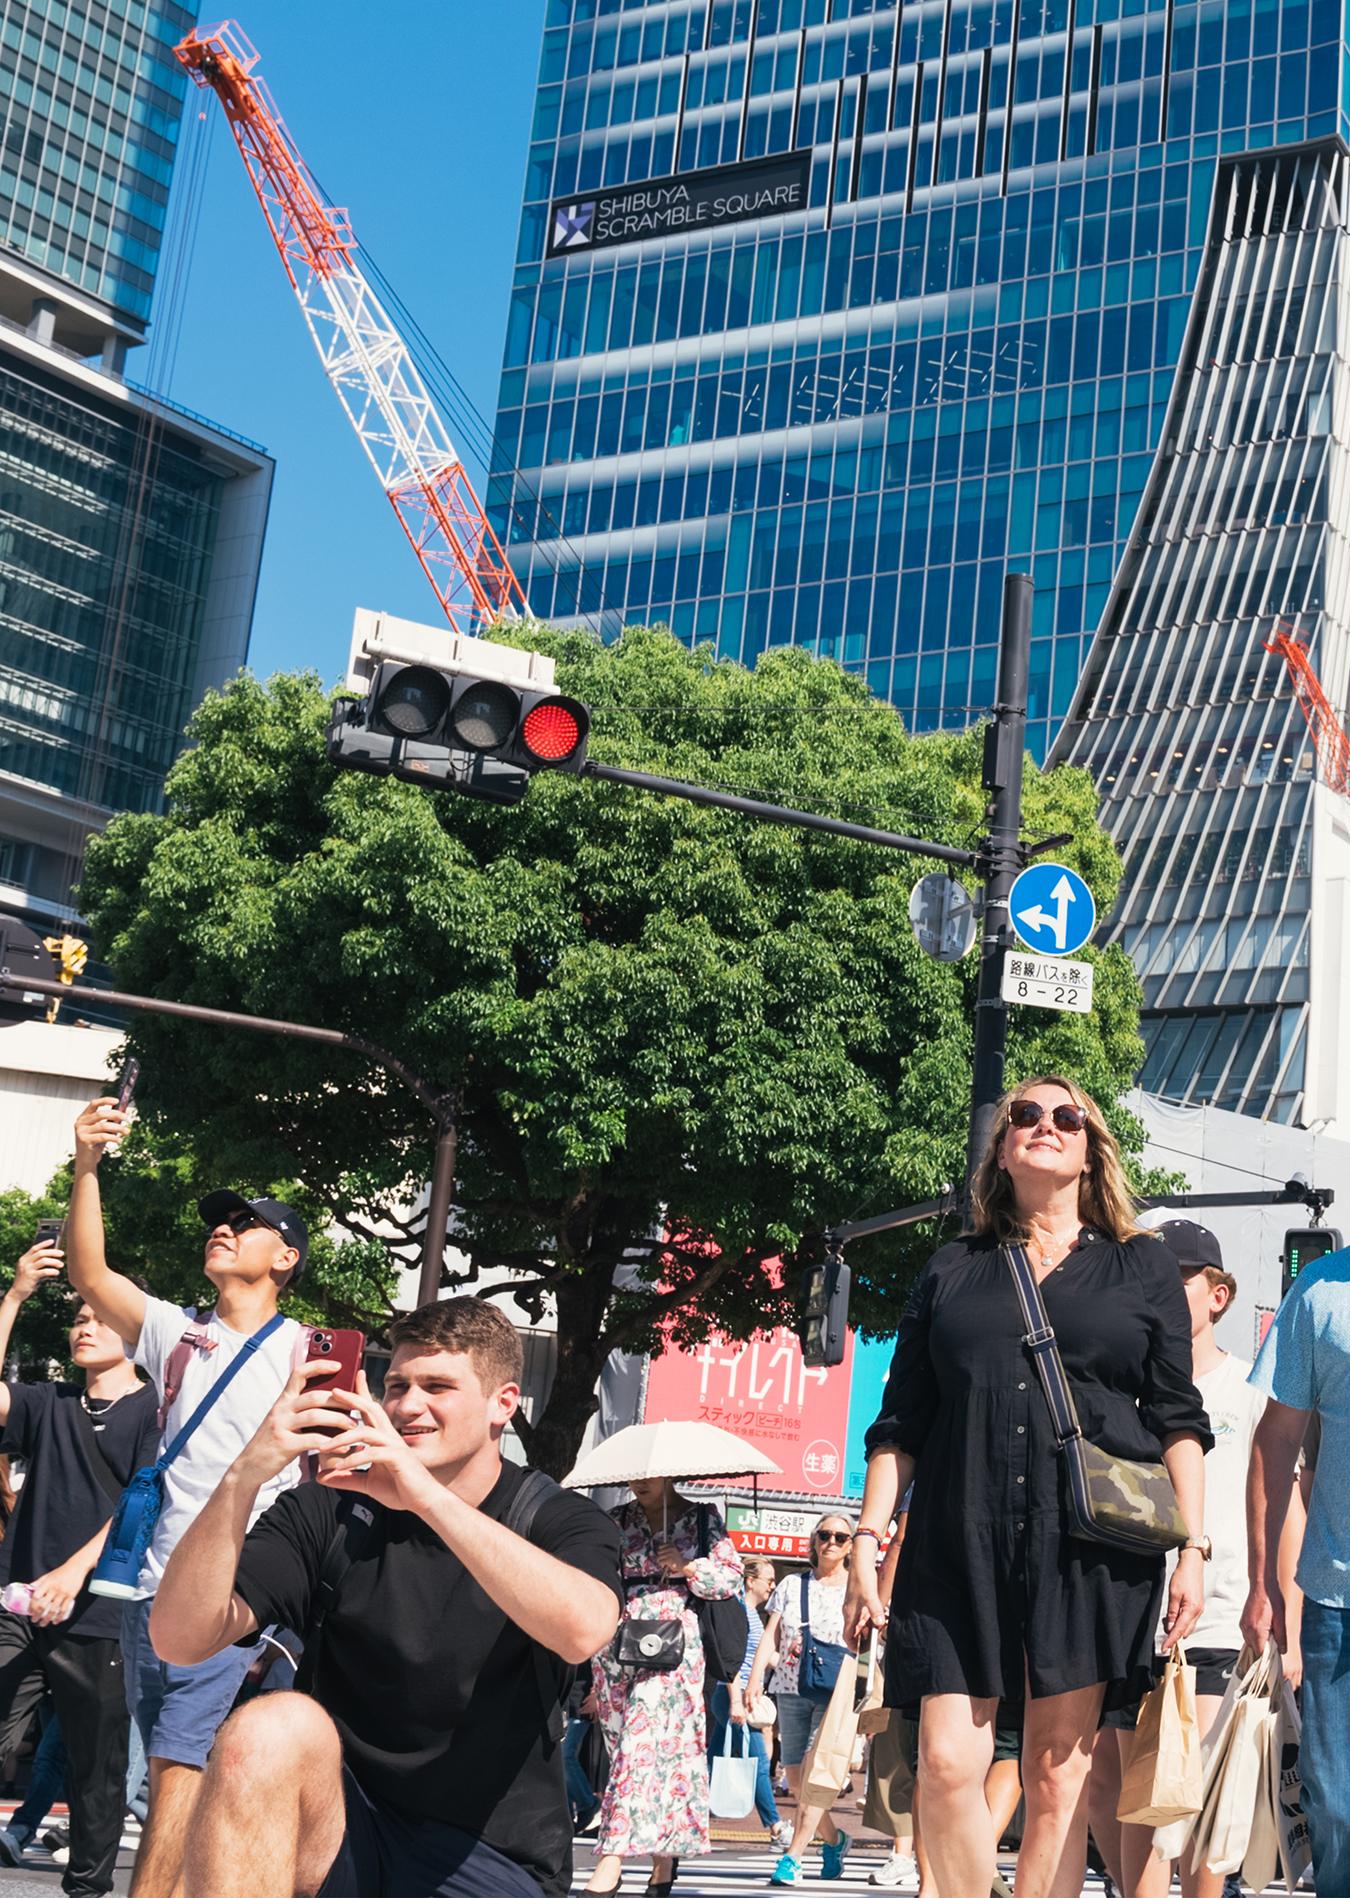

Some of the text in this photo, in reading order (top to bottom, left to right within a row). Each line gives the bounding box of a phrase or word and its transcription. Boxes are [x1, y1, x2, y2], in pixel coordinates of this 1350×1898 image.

[596, 183, 801, 240] SCRAMBLE SQUARE
[599, 185, 690, 218] SHIBUYA
[1010, 959, 1088, 986] 路線バスを除く
[699, 1394, 804, 1414] DIRECT
[697, 1405, 756, 1425] スティック
[805, 1452, 837, 1474] 生薬
[767, 1513, 806, 1533] 渋谷駅
[740, 1534, 794, 1552] 入口専用
